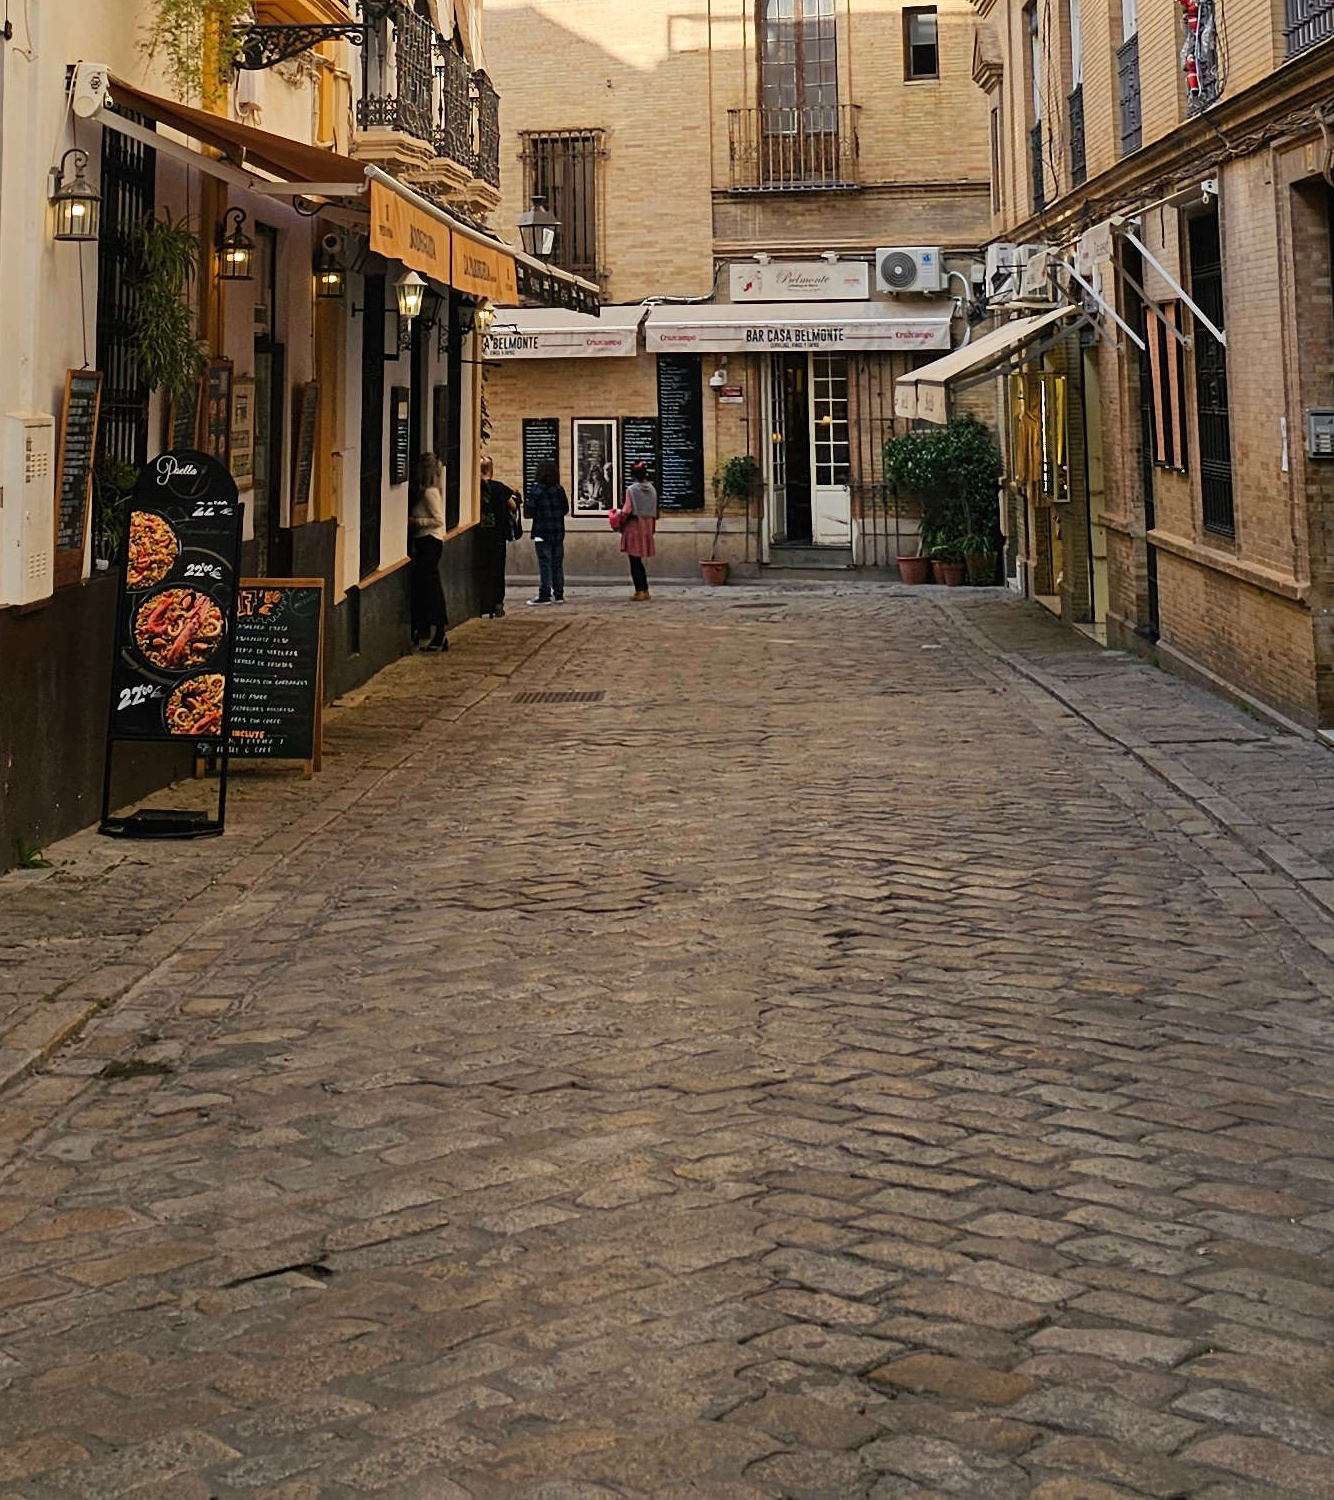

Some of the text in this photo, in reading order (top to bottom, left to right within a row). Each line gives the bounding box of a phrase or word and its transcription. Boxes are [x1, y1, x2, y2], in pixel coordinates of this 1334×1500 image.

[746, 327, 844, 343] BAR CASA BELMONTE
[493, 336, 539, 350] BELMONTE
[156, 455, 198, 486] Paella
[231, 729, 266, 739] INCLUYE
